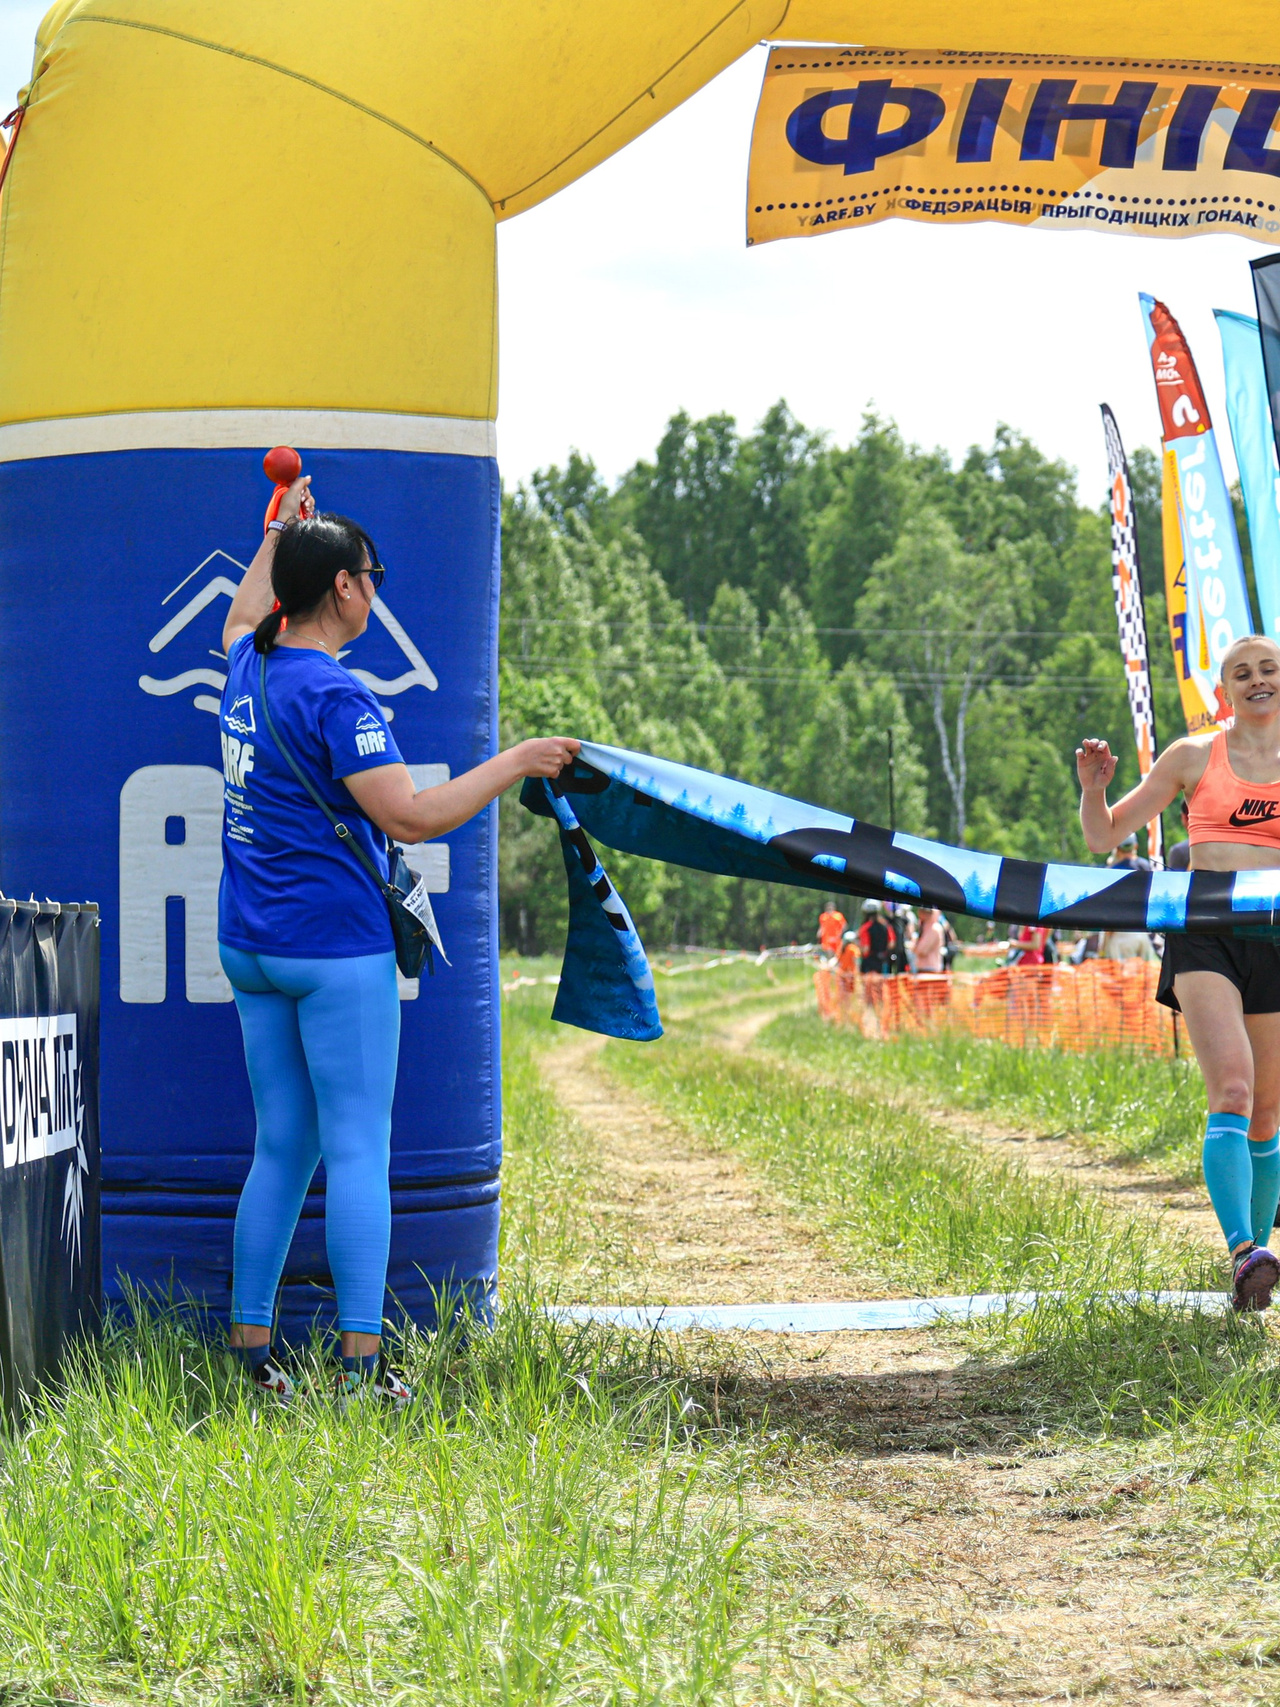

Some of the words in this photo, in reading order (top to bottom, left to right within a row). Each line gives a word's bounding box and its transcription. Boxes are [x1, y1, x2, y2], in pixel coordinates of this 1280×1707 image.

[812, 203, 877, 226] ARF.BY
[905, 198, 1032, 215] ФЕДЭРАЦЫЯ
[1042, 203, 1190, 227] ПРЫГОДНІЦКІХ
[1197, 207, 1257, 227] ГОНАК
[355, 731, 387, 756] ARF
[1238, 798, 1279, 818] NIKE
